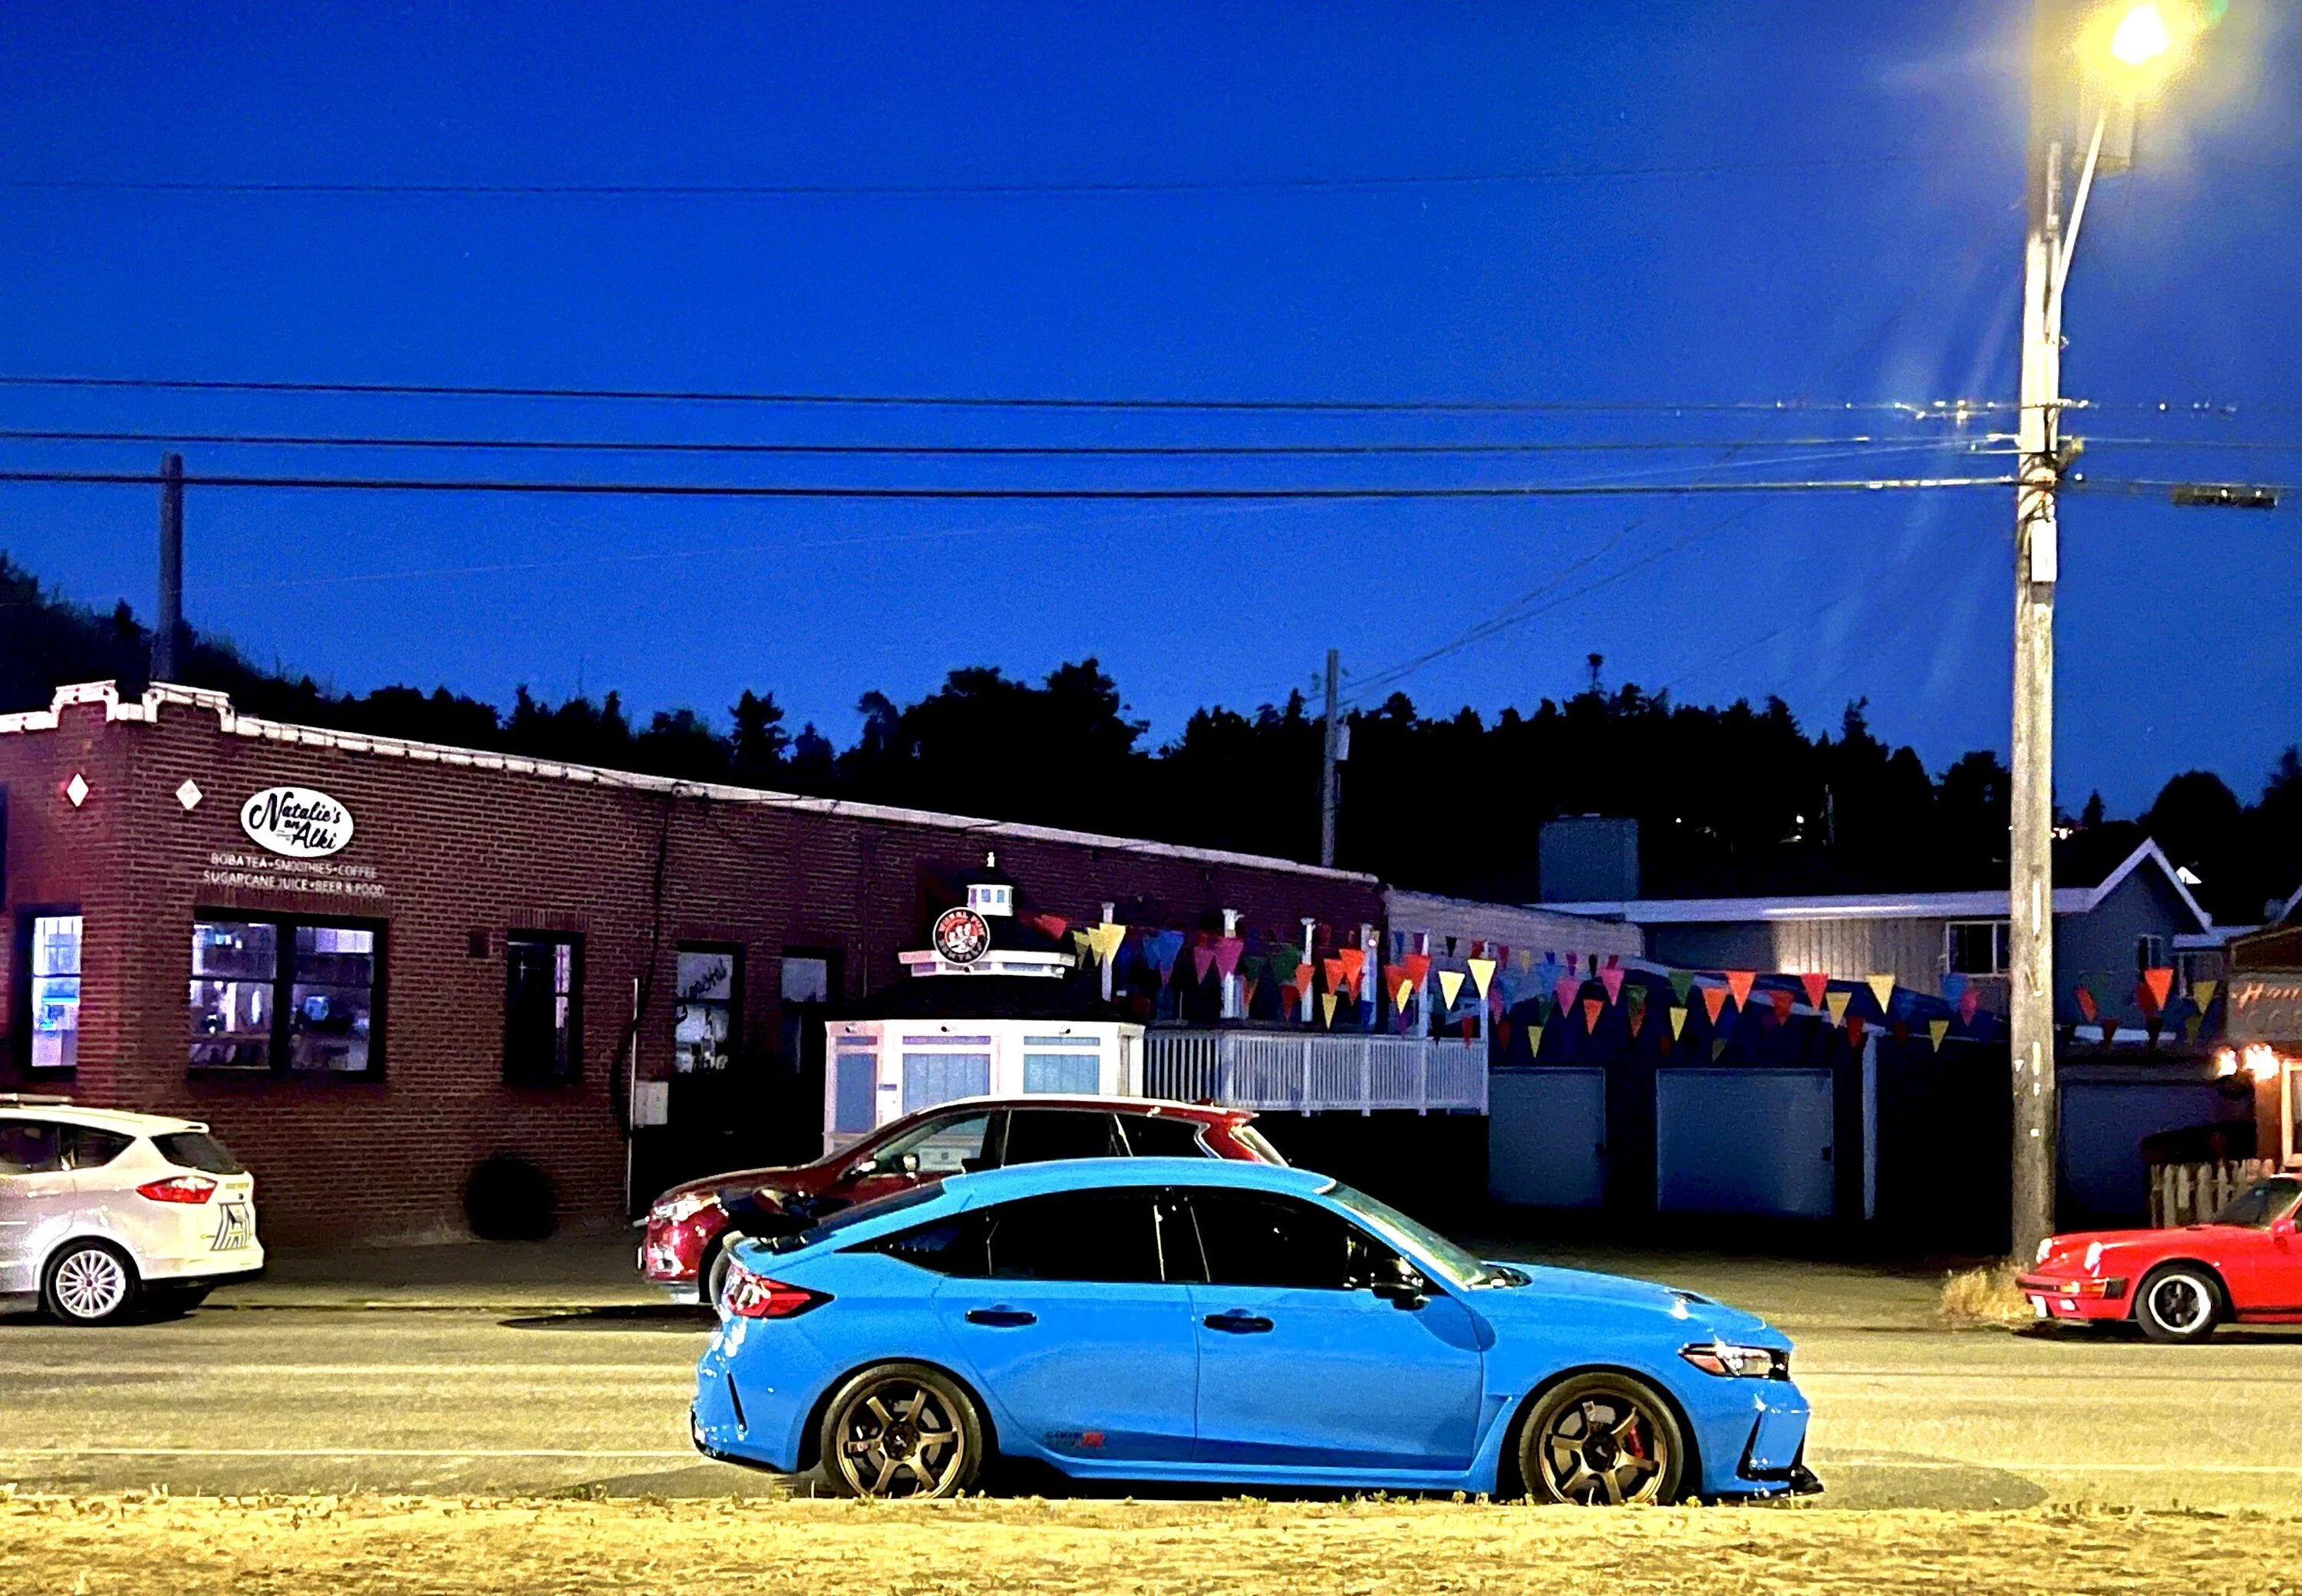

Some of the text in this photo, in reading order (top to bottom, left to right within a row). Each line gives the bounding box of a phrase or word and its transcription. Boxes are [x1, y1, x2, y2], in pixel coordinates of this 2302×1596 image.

[249, 791, 341, 832] Natalie's
[291, 821, 337, 849] Alki
[210, 852, 378, 879] BOBA TEA SMOOTHIES COFFEE
[203, 869, 276, 887] SUGARCANE
[278, 877, 308, 891] JUICE
[315, 879, 343, 893] BEER
[354, 882, 384, 898] FOOD
